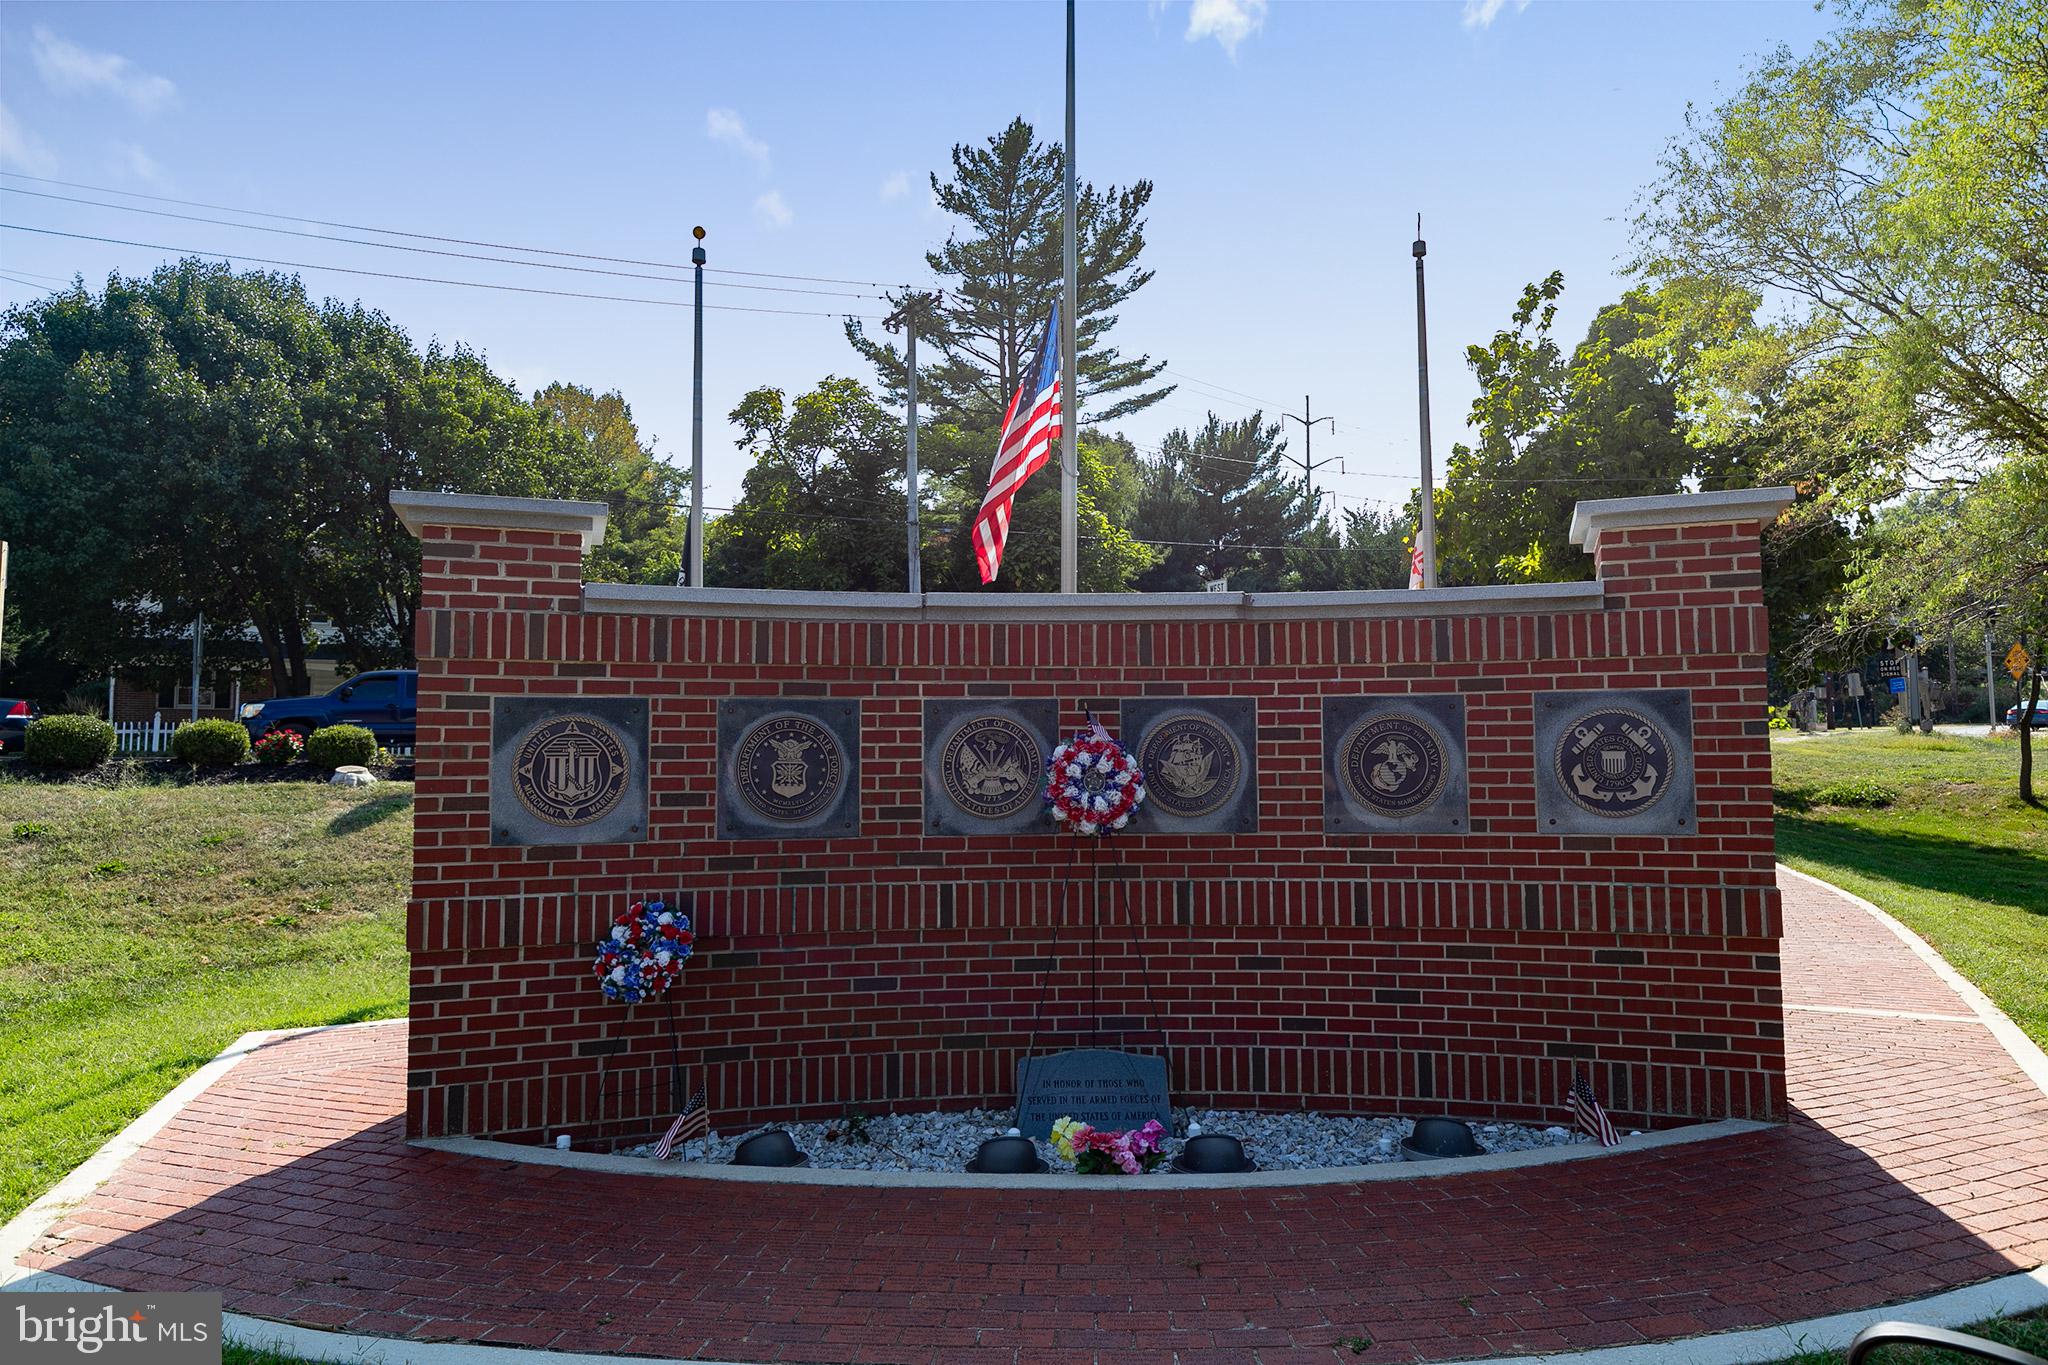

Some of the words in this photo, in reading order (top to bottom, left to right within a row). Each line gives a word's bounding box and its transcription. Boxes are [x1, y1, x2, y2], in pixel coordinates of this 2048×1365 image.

[523, 730, 551, 759] UNITED
[591, 728, 619, 757] STATES
[946, 720, 989, 763] DEPARTMENT
[1009, 724, 1024, 738] THE
[1024, 740, 1038, 763] ARMY
[1148, 724, 1187, 760] DEPARTMENT
[1202, 726, 1217, 739] THE
[1216, 738, 1230, 757] NAVY
[1351, 722, 1400, 768] DEPARTMENT
[1425, 740, 1439, 768] NAVY
[1590, 736, 1615, 755] STATES
[1617, 736, 1638, 755] COAST
[741, 726, 772, 785] DEPARTMENT
[795, 721, 816, 735] THE
[817, 734, 833, 751] AIR
[826, 755, 839, 789] FORCE
[612, 766, 616, 774] E
[1587, 755, 1604, 782] UNITED
[1626, 757, 1642, 782] GUARD
[523, 784, 560, 816] MERCHANT
[588, 787, 617, 814] MARINE
[945, 770, 964, 801] UNITED
[966, 801, 1000, 813] STATES
[1002, 803, 1013, 811] OF
[1014, 770, 1039, 805] AMERICA
[569, 808, 573, 816] S
[1042, 1080, 1050, 1088] IN
[1054, 1080, 1081, 1088] HONOR
[1099, 1080, 1122, 1088] THOSE
[1126, 1079, 1145, 1087] WHO
[1027, 1096, 1056, 1105] SERVED
[1060, 1096, 1068, 1104] IN
[1071, 1096, 1085, 1104] THE
[1088, 1096, 1116, 1104] ARMED
[1120, 1095, 1149, 1104] FORCES
[1152, 1095, 1161, 1103] OF
[1031, 1112, 1046, 1121] THE
[1081, 1112, 1109, 1121] STATES
[1112, 1112, 1121, 1120] OF
[1124, 1112, 1161, 1120] AMERICA
